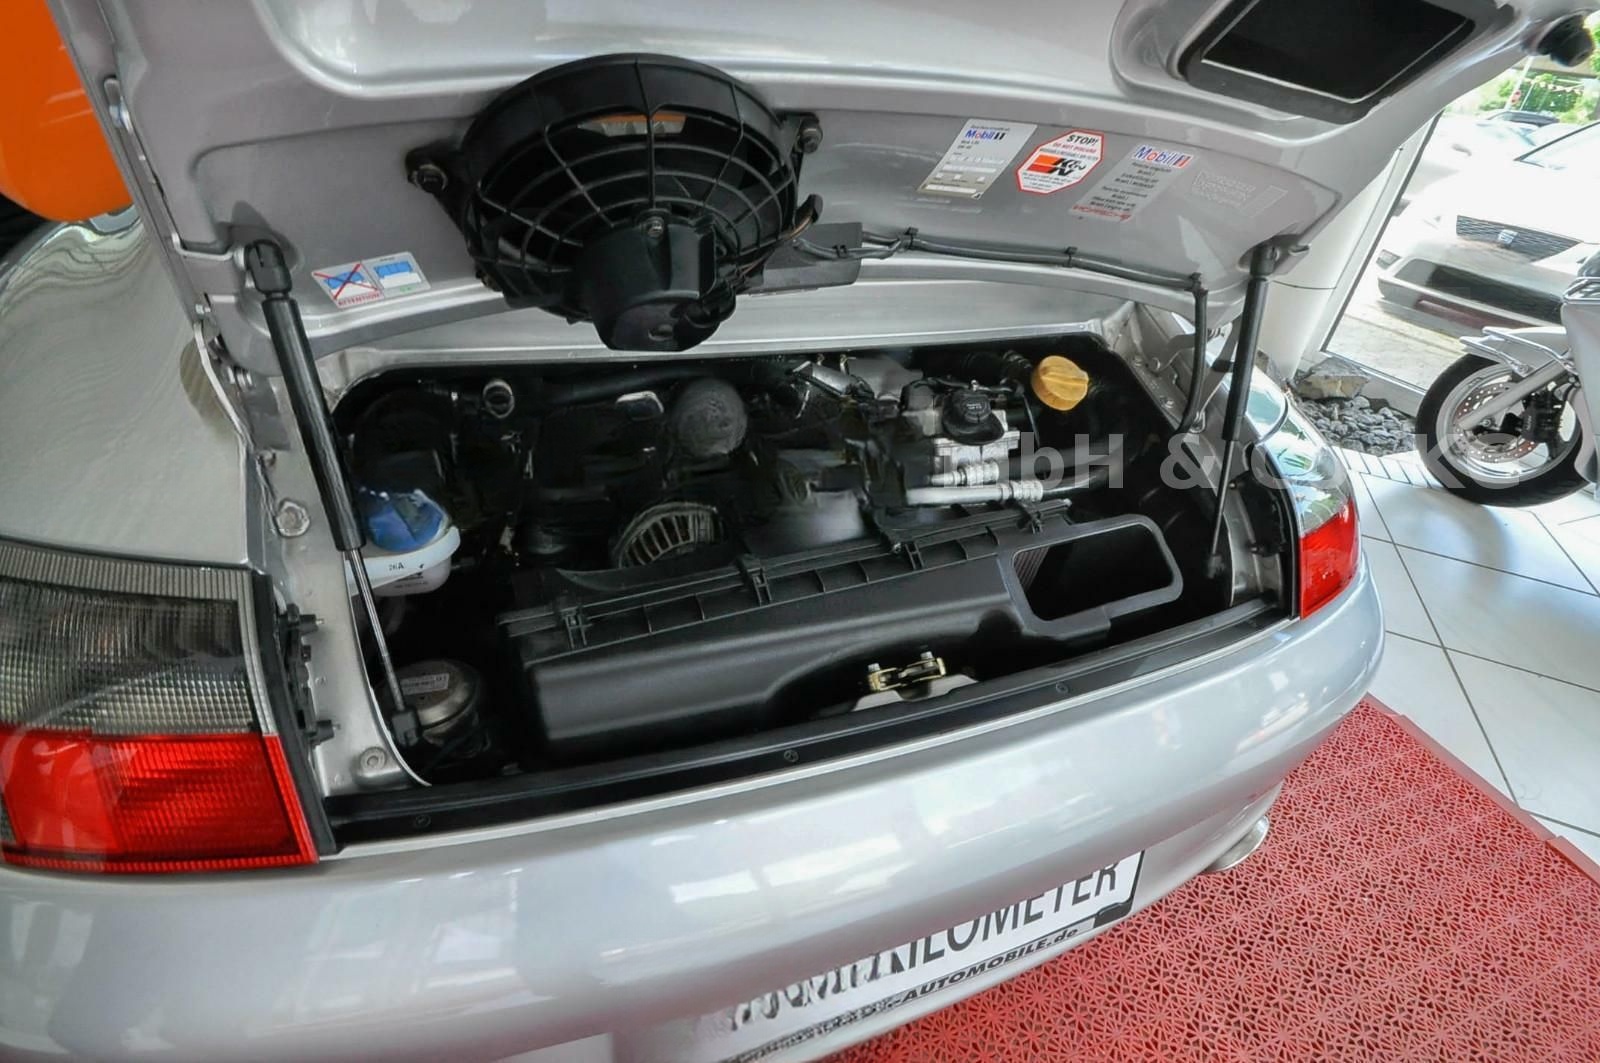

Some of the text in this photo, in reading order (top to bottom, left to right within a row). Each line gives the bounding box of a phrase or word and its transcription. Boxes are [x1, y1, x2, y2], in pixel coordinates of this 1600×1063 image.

[965, 129, 994, 140] Mobil
[1067, 134, 1099, 146] STOP!
[1134, 146, 1175, 166] Mobil
